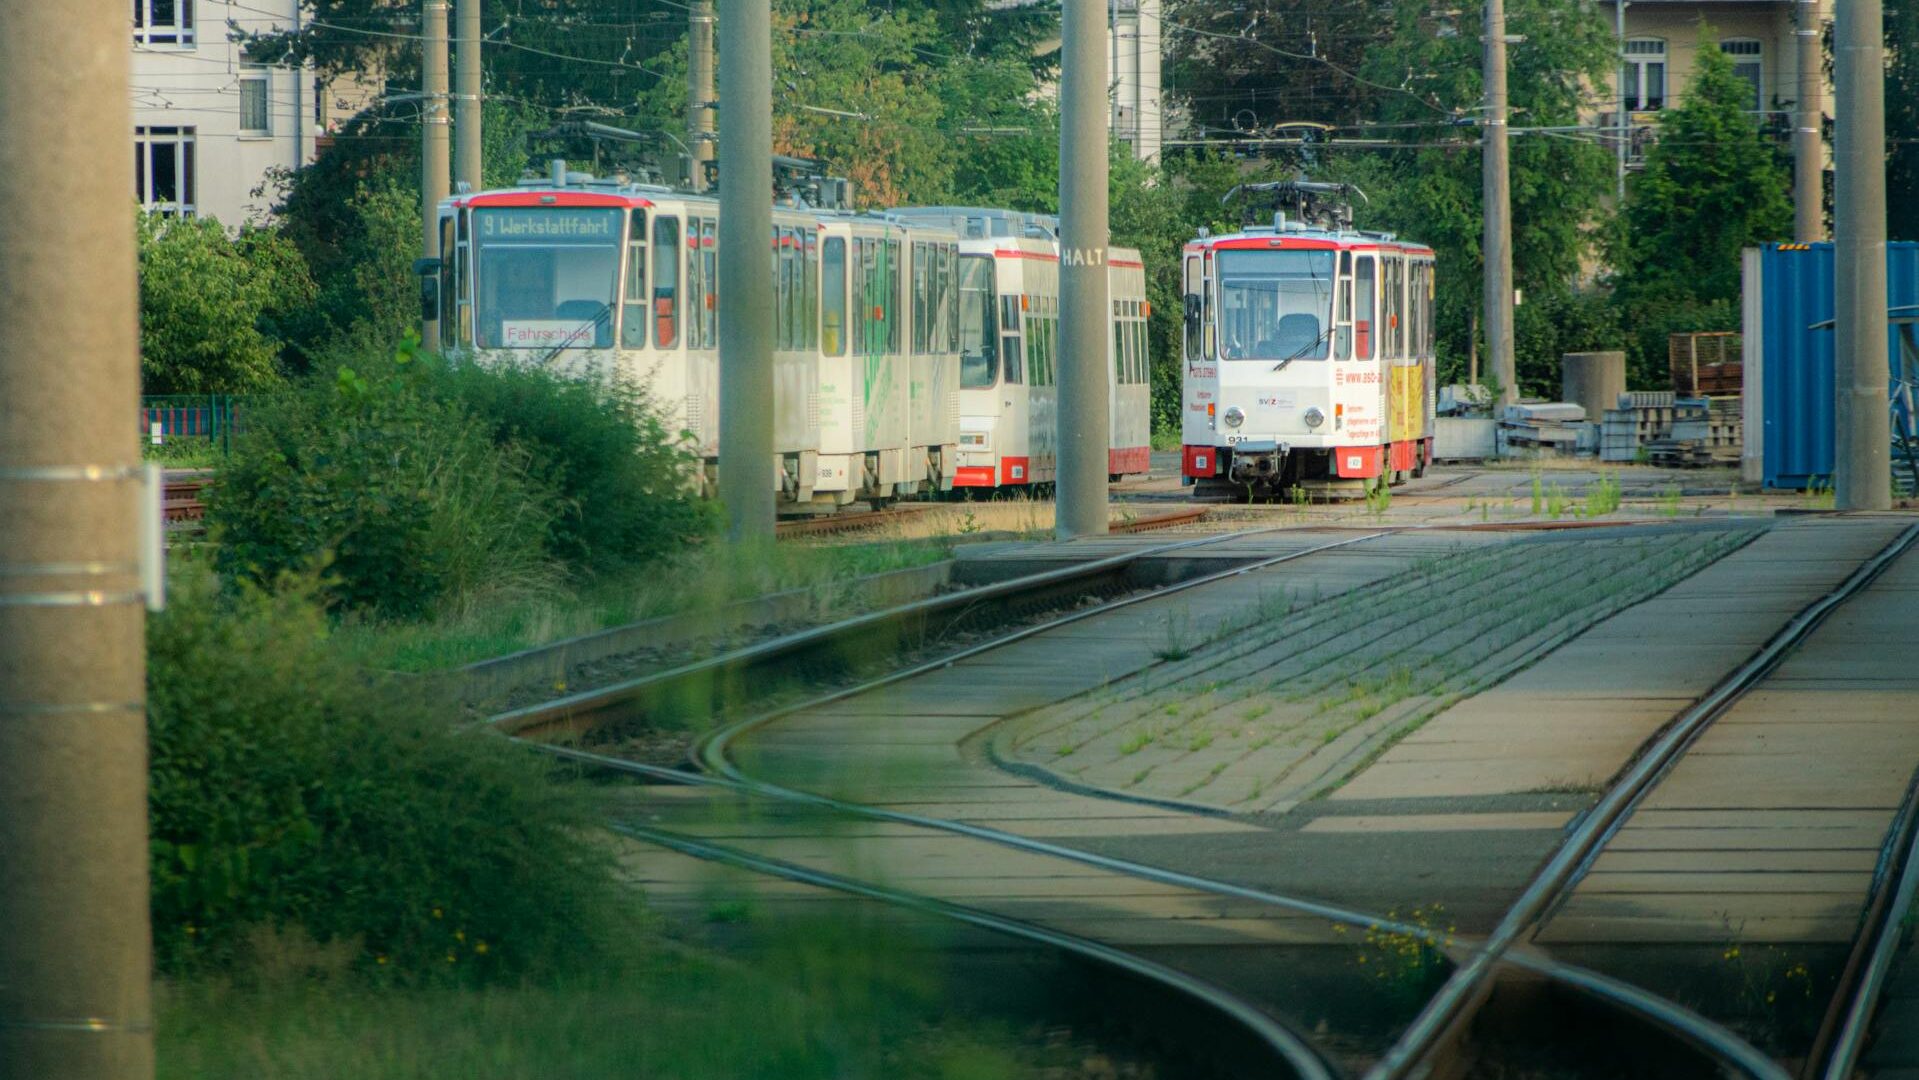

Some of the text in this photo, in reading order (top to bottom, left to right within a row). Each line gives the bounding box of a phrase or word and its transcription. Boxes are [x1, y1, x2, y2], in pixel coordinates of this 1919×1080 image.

[484, 215, 609, 236] 9 Werkstattfahrt
[1062, 248, 1104, 266] HALT
[507, 327, 591, 341] Fahrschule
